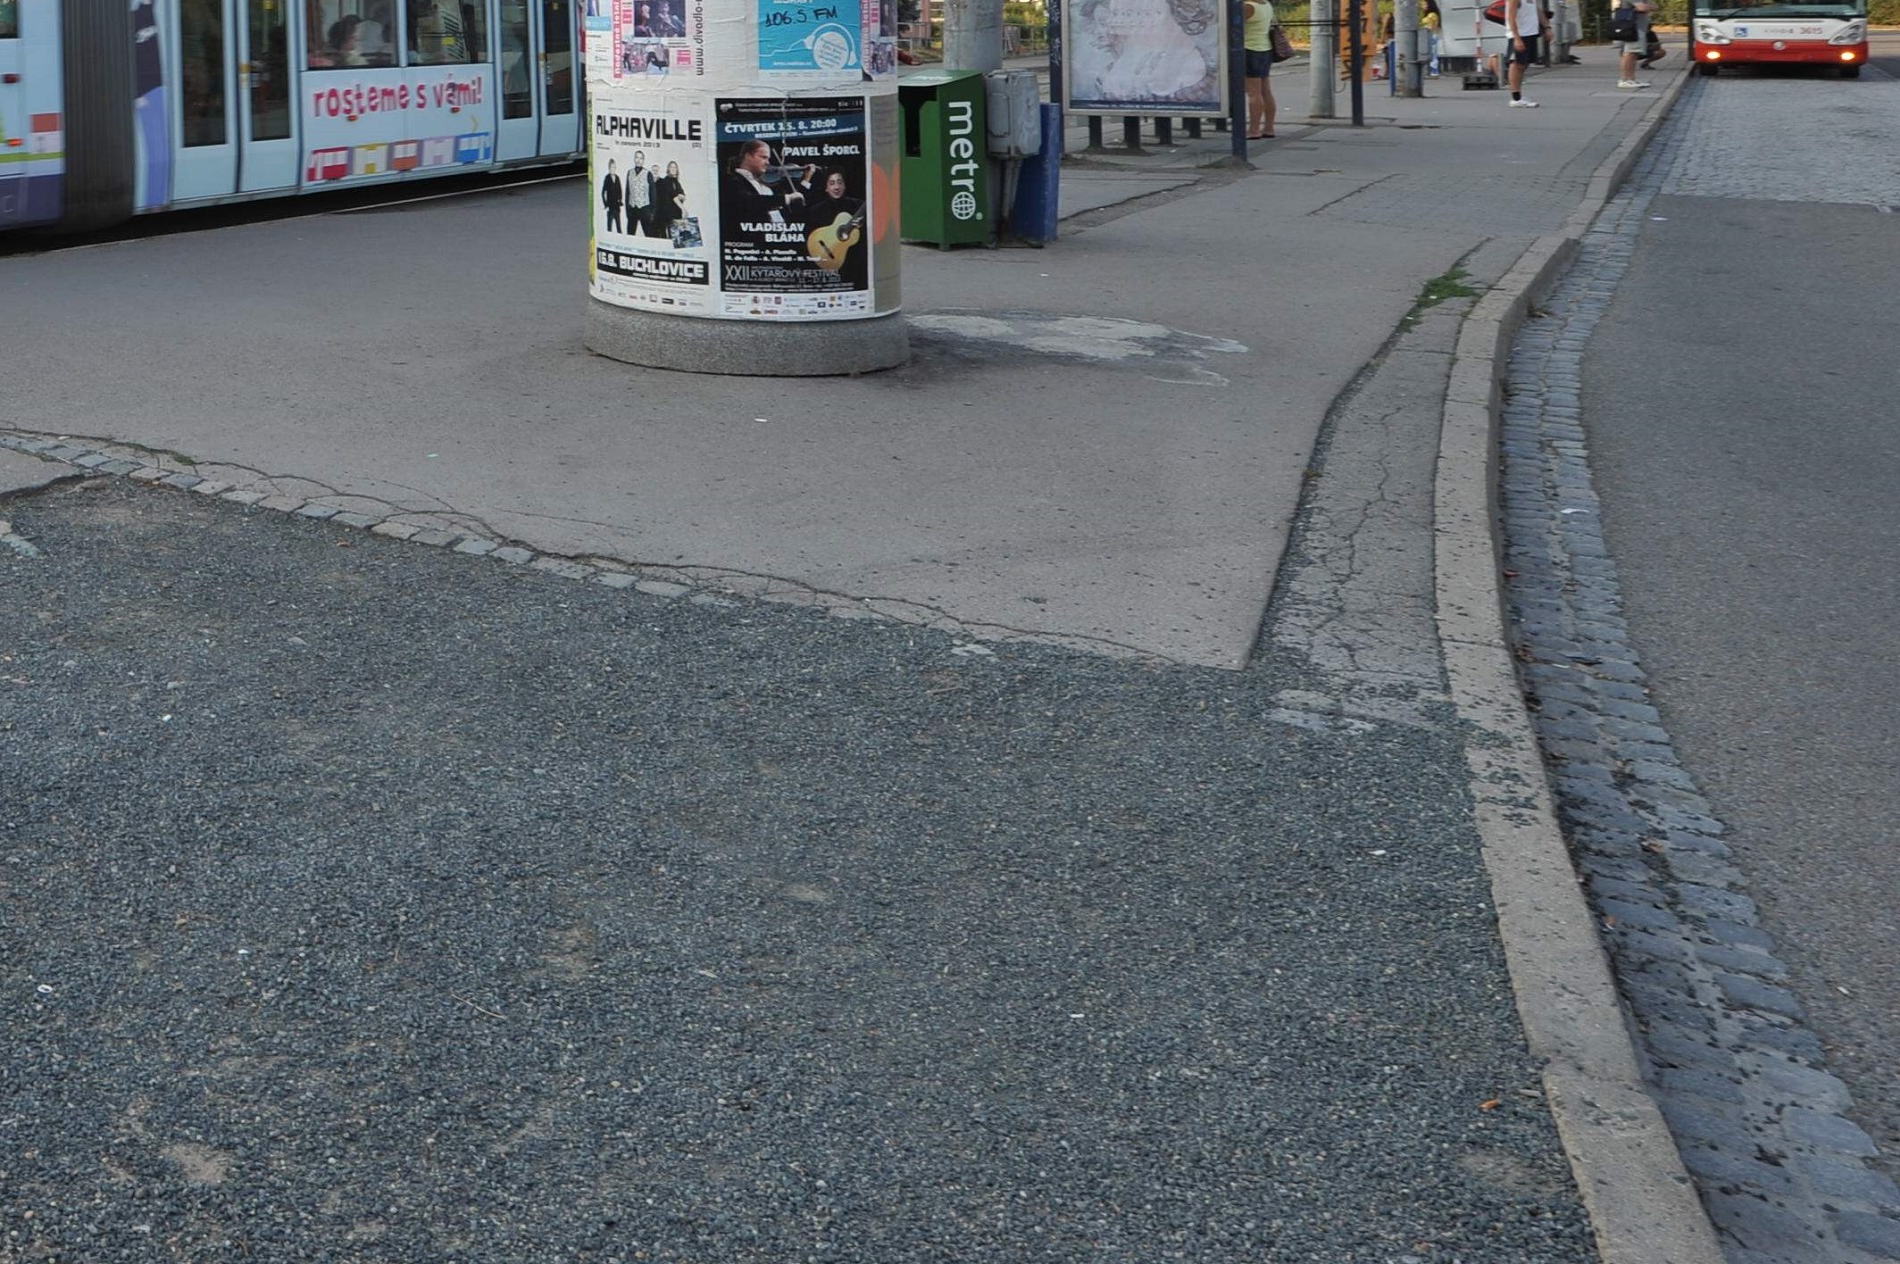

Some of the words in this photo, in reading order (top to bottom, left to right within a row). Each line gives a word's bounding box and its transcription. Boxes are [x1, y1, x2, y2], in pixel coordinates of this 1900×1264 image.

[765, 9, 807, 27] 106.5
[813, 6, 838, 21] FM
[314, 84, 410, 117] rosteme
[416, 84, 427, 109] s
[433, 73, 482, 109] vámi!
[596, 115, 702, 141] ALPHAVILLE
[725, 122, 776, 133] ČTVRTEK
[811, 118, 837, 129] 20:00
[783, 146, 820, 156] PAVEL
[823, 144, 860, 156] ŠPORCL
[948, 101, 980, 220] metro
[740, 222, 805, 232] VLADISLAV
[765, 233, 805, 242] BLÁHA
[619, 256, 704, 278] BUCHLOVICE
[725, 265, 750, 281] XXII
[751, 267, 800, 277] KYTAROVÝ
[803, 269, 840, 277] FESTIVAL
